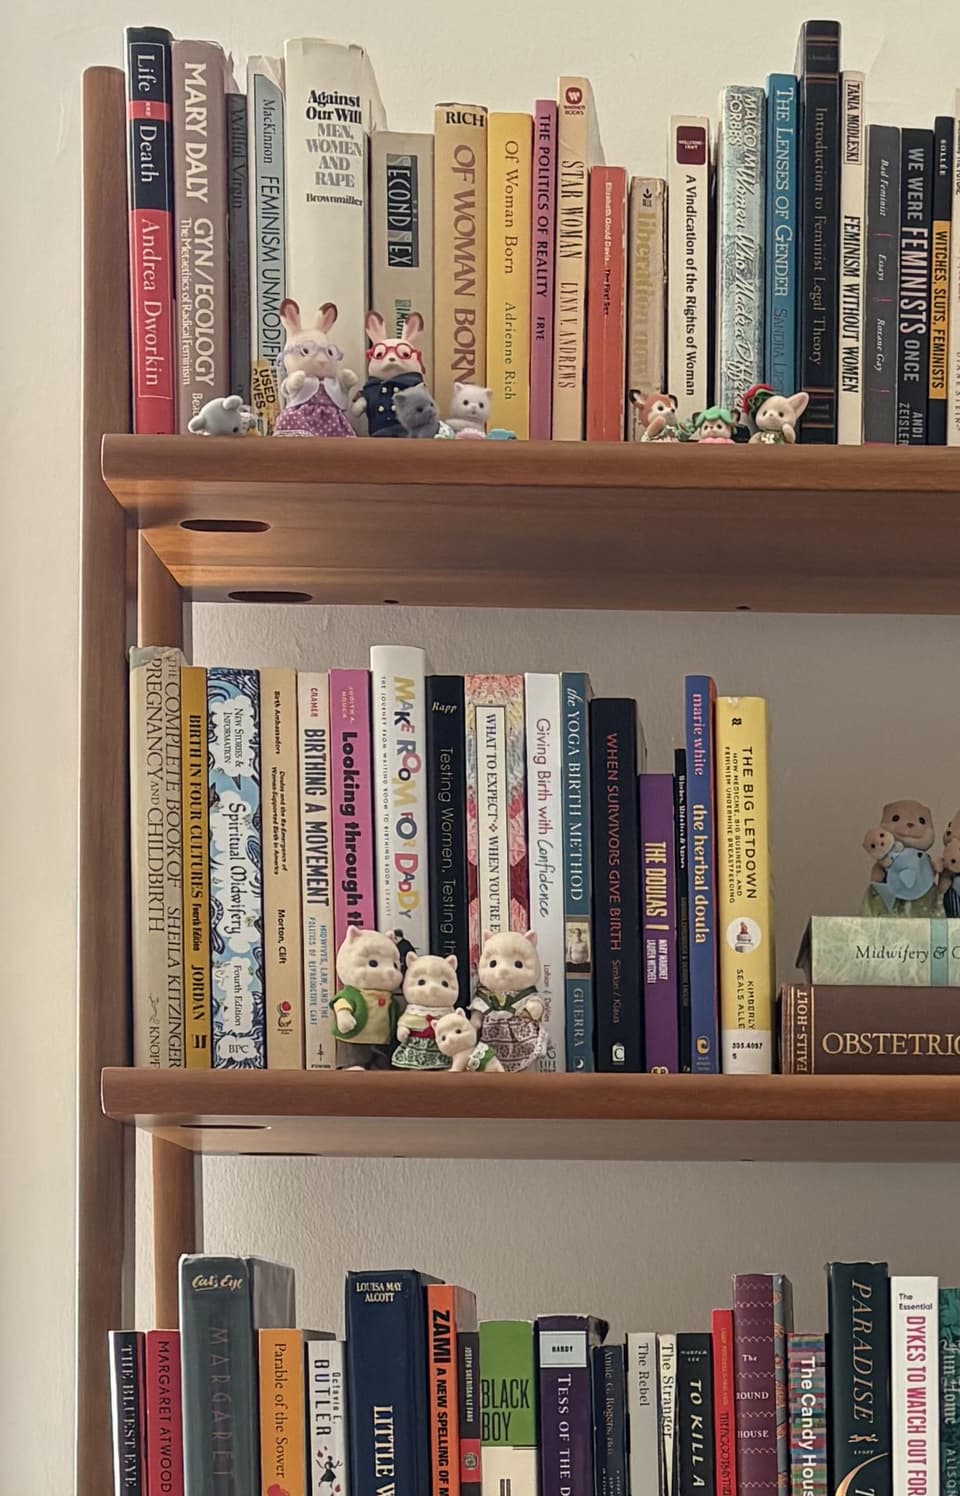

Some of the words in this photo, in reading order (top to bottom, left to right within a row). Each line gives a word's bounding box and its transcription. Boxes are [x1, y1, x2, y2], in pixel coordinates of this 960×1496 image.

[136, 53, 156, 92] Life
[308, 89, 361, 108] Against
[306, 106, 332, 122] Our
[335, 108, 362, 124] Will
[446, 112, 484, 127] RICH
[138, 124, 159, 183] Death
[306, 139, 363, 156] WOMEN
[318, 157, 350, 171] AND
[685, 175, 696, 183] A
[315, 172, 354, 188] RAPE
[685, 186, 696, 255] Vindication
[141, 218, 157, 292] Andrea
[686, 258, 697, 269] of
[686, 273, 696, 293] the
[684, 296, 696, 334] Rights
[142, 301, 159, 386] Dworkin
[686, 336, 697, 348] of
[686, 350, 697, 396] Woman
[305, 729, 325, 796] BIRTHING
[742, 747, 753, 767] THE
[743, 772, 754, 797] BIG
[305, 802, 326, 813] A
[227, 803, 246, 869] Spiritual
[743, 802, 758, 899] LETDOWN
[305, 821, 330, 906] MOVEMENT
[225, 870, 246, 934] Midwifery
[856, 945, 929, 963] Midwifery
[933, 946, 947, 960] &
[233, 964, 242, 994] Fourth
[233, 995, 242, 1026] Edition
[906, 1316, 926, 1361] DYKES
[907, 1366, 926, 1383] TO
[482, 1379, 530, 1409] BLACK
[907, 1386, 927, 1434] WATCH
[373, 1406, 393, 1477] LITTLE
[482, 1412, 510, 1443] BOY
[907, 1438, 927, 1465] OUT
[907, 1468, 927, 1496] FOR
